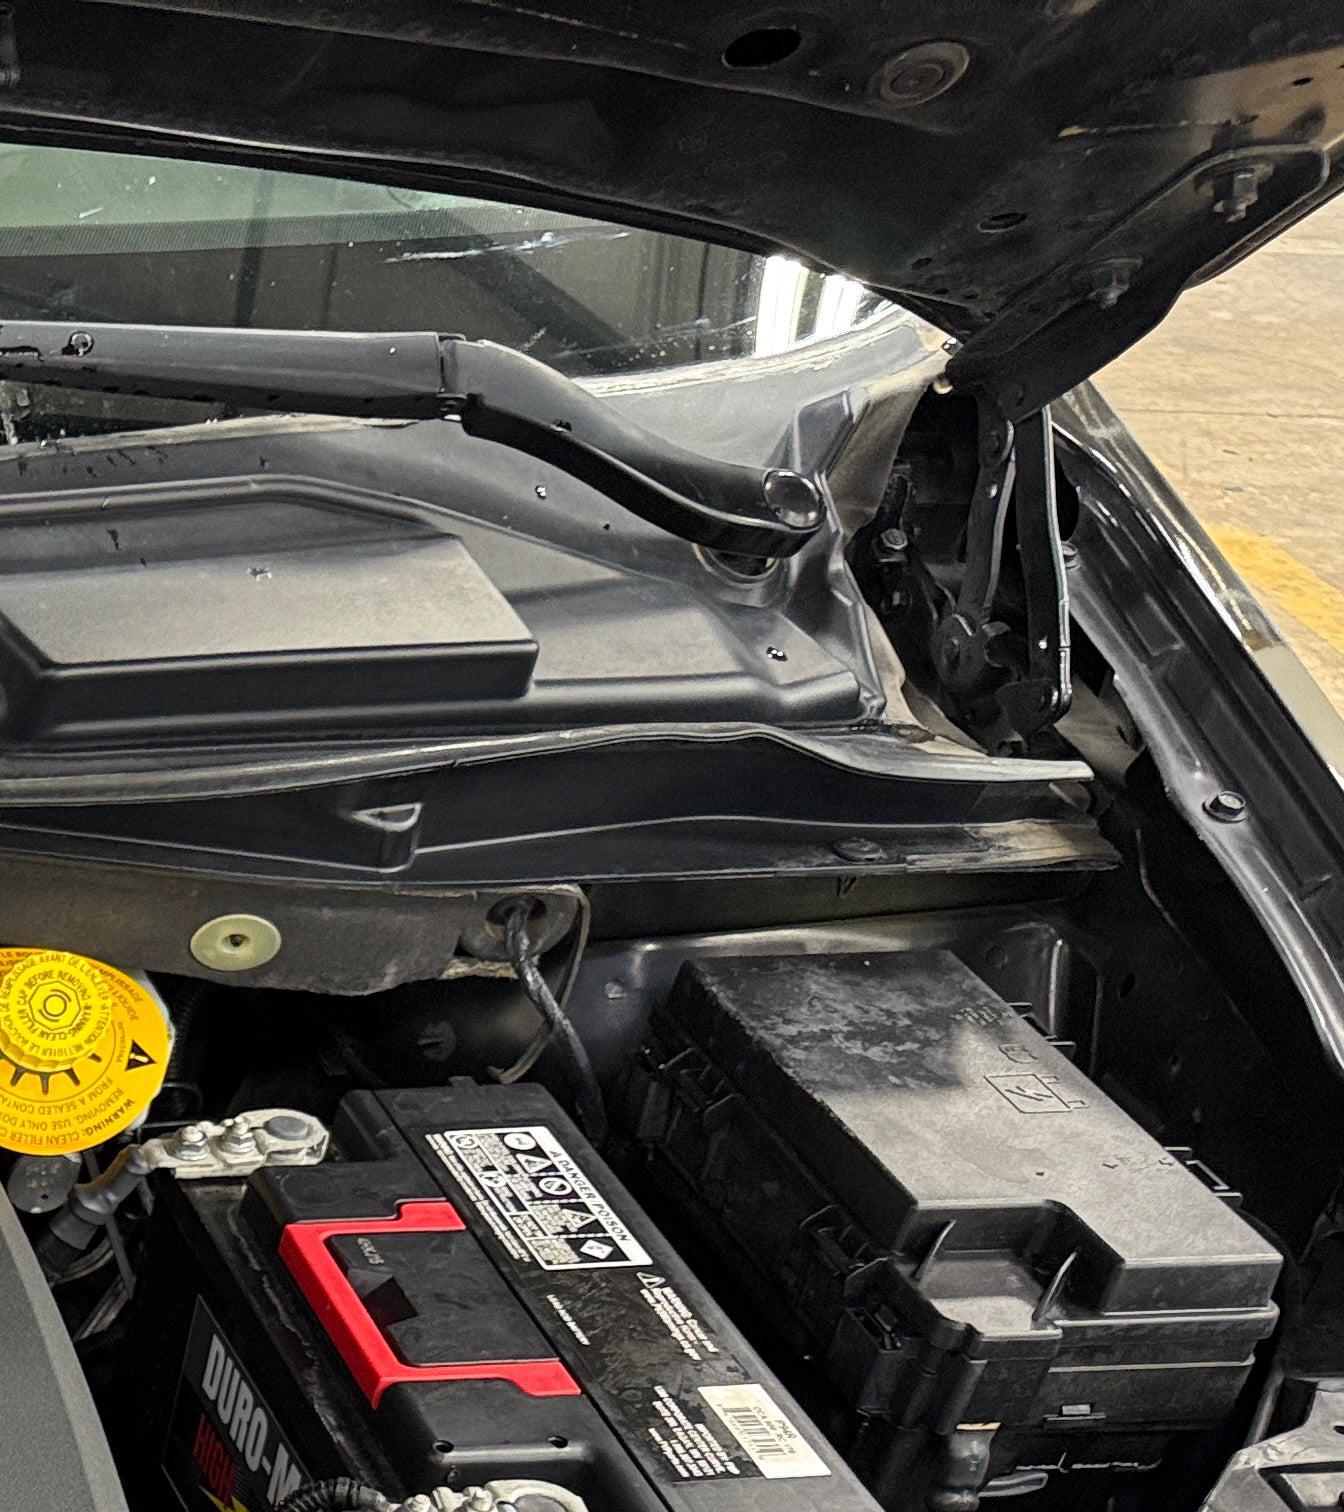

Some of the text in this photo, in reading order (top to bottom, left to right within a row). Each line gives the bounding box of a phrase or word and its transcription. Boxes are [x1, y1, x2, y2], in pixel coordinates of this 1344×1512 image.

[88, 1076, 114, 1105] FROM
[36, 1100, 78, 1116] SEALED
[18, 1118, 49, 1132] ONLY
[51, 1118, 73, 1132] USE
[81, 1098, 136, 1138] WARNING:
[9, 1132, 44, 1147] FILLER
[46, 1130, 81, 1147] CLEAN
